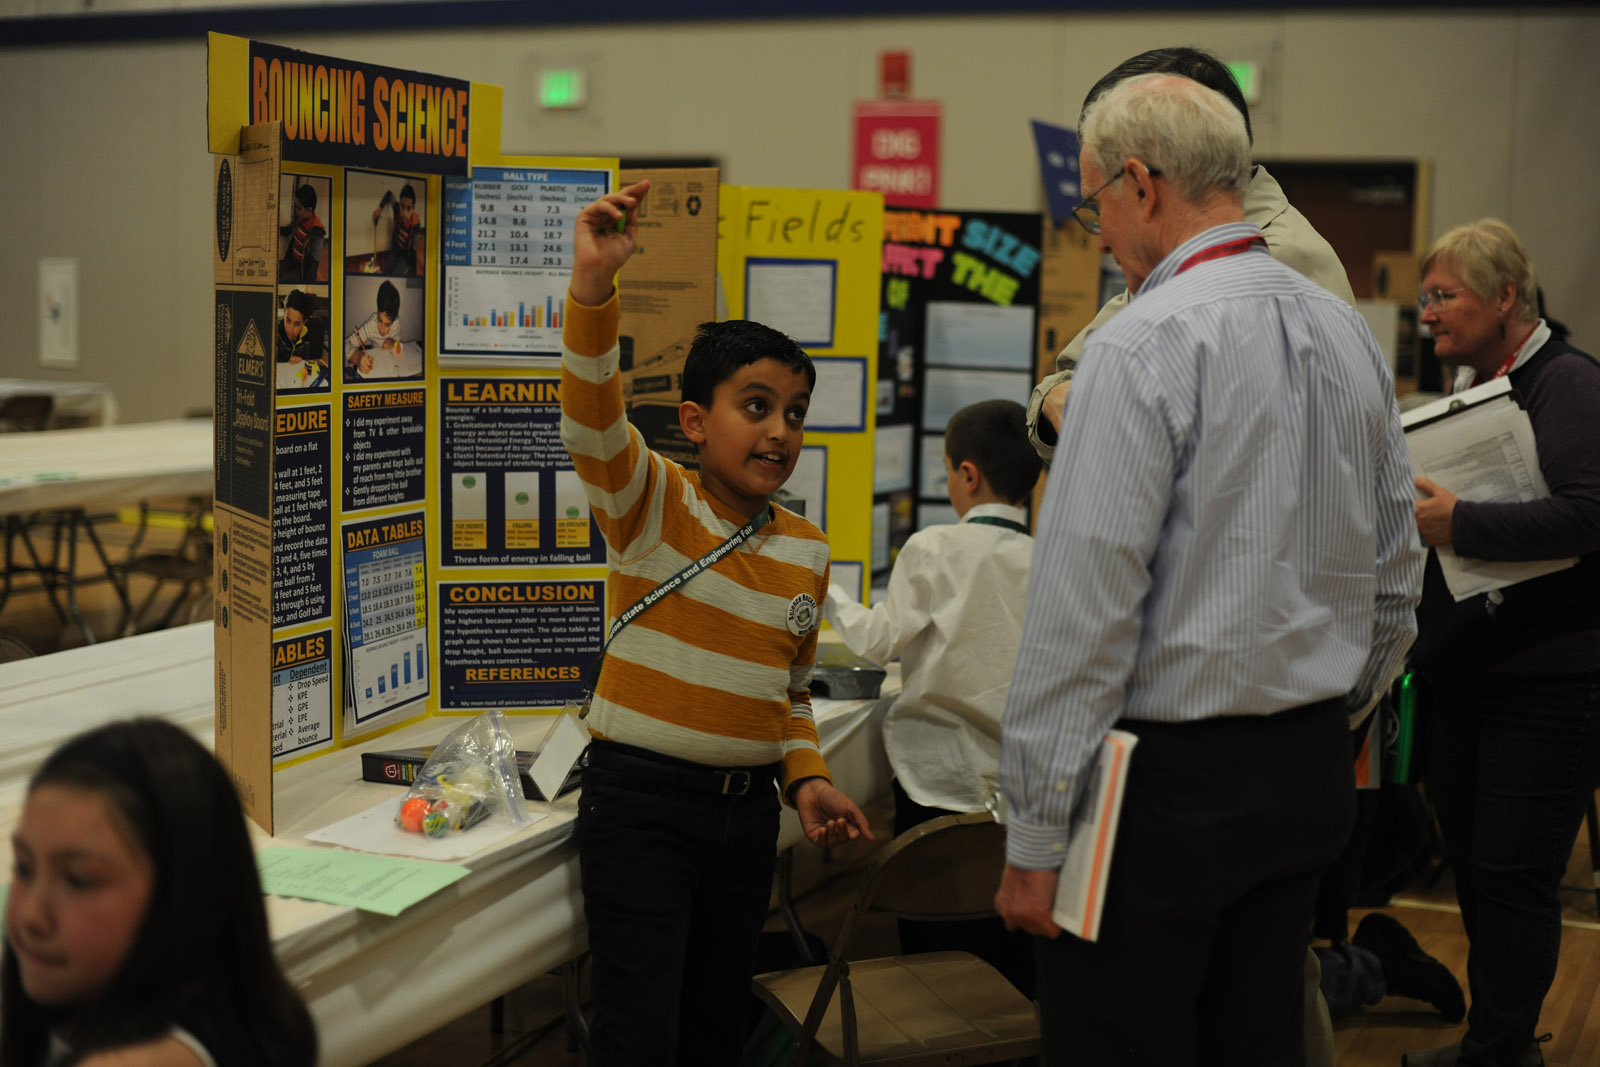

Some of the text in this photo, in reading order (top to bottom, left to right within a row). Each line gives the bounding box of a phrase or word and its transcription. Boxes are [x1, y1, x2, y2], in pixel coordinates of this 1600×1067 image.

[254, 57, 365, 146] BOUNCING
[373, 76, 467, 158] SCIENCE
[503, 172, 548, 181] BALL TYPE
[513, 205, 526, 213] 4.3
[547, 206, 560, 214] 7.3
[479, 217, 497, 225] 14.8
[513, 218, 526, 226] 8.6
[746, 200, 864, 244] Fields
[478, 230, 496, 238] 21.2
[478, 243, 562, 252] 27.1 13.1 24.6
[962, 218, 1042, 278] SIZE
[543, 257, 561, 265] 28.3
[951, 252, 1020, 307] THE
[238, 358, 264, 378] ELMER'S
[236, 387, 256, 408] Tri-Fold
[448, 383, 561, 402] LEARNIN
[348, 392, 423, 408] SAFETY MEASURE
[235, 408, 269, 432] Display Board
[277, 410, 327, 432] EDURE
[374, 416, 400, 426] experiment
[276, 444, 293, 455] board
[308, 442, 318, 451] flat
[278, 464, 322, 478] wall at 1 feet, 2
[279, 481, 293, 490] feet,
[294, 478, 305, 488] and
[307, 478, 310, 487] 5
[311, 477, 323, 486] feet
[276, 490, 320, 502] measuring tape
[284, 505, 291, 513] at
[292, 504, 295, 512] 1
[297, 502, 308, 511] feet
[310, 499, 327, 509] height
[282, 516, 292, 526] the
[293, 513, 312, 524] board.
[278, 524, 326, 538] height of bounce
[348, 519, 423, 548] DATA TABLES
[284, 539, 303, 551] record
[304, 538, 314, 548] the
[315, 537, 328, 546] data
[500, 555, 509, 563] of
[550, 554, 574, 563] falling
[622, 524, 754, 622] State Science and Engineering Fair
[450, 585, 594, 602] CONCLUSION
[275, 636, 325, 665] ABLES
[290, 662, 327, 680] Dependent
[466, 666, 580, 680] REFERENCES
[297, 675, 328, 689] Drop Speed
[298, 691, 308, 700] KPE
[298, 702, 308, 711] GPE
[298, 713, 308, 722] EPE
[298, 722, 320, 734] Average
[298, 733, 318, 745] bounce
